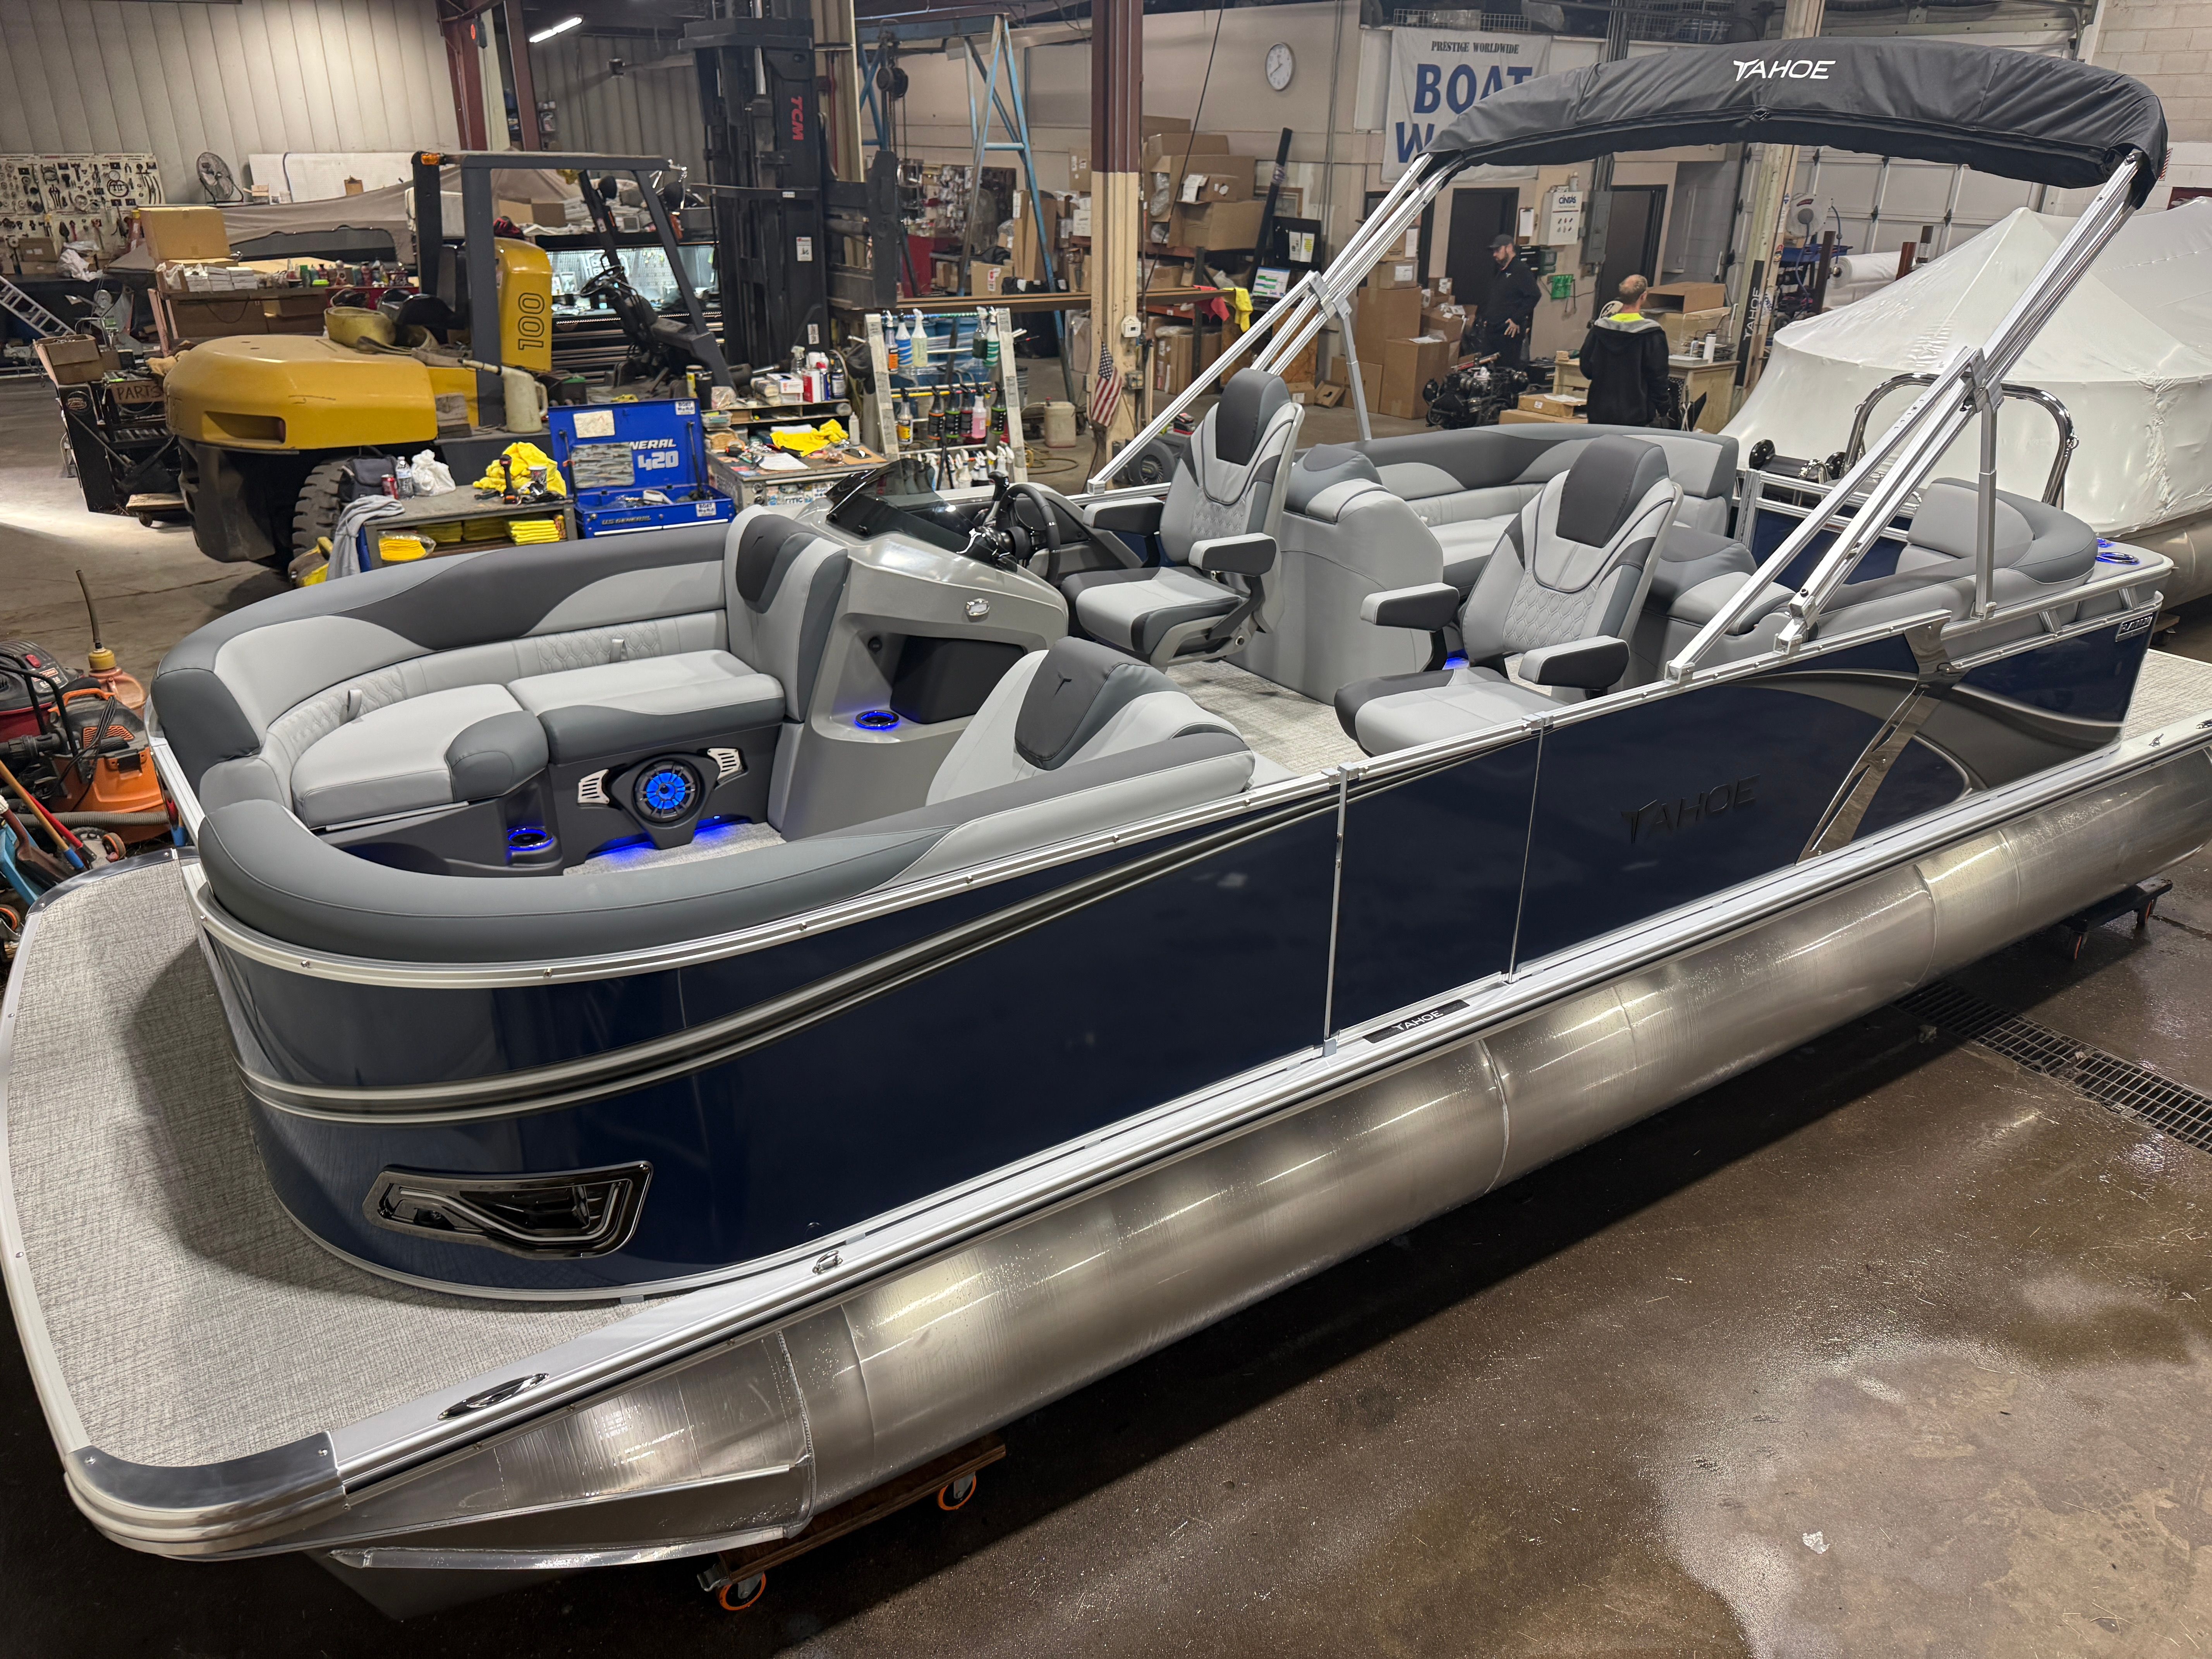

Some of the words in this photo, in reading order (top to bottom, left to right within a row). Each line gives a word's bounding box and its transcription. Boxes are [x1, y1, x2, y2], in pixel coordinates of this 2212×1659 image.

[1431, 41, 1470, 52] PRESTIGE
[1473, 42, 1520, 54] WORLDWIDE
[1733, 58, 1836, 82] TAHOE
[1413, 63, 1533, 115] BOAT
[791, 96, 804, 141] TCM
[1558, 194, 1577, 204] CINTAS
[518, 292, 545, 350] 100
[1743, 287, 1760, 341] TAHOE
[117, 385, 164, 400] PARTS
[629, 438, 677, 450] NERAL
[638, 450, 679, 471] 420
[1620, 773, 1760, 844] TAHOE
[1391, 1010, 1444, 1031] TAHOE
